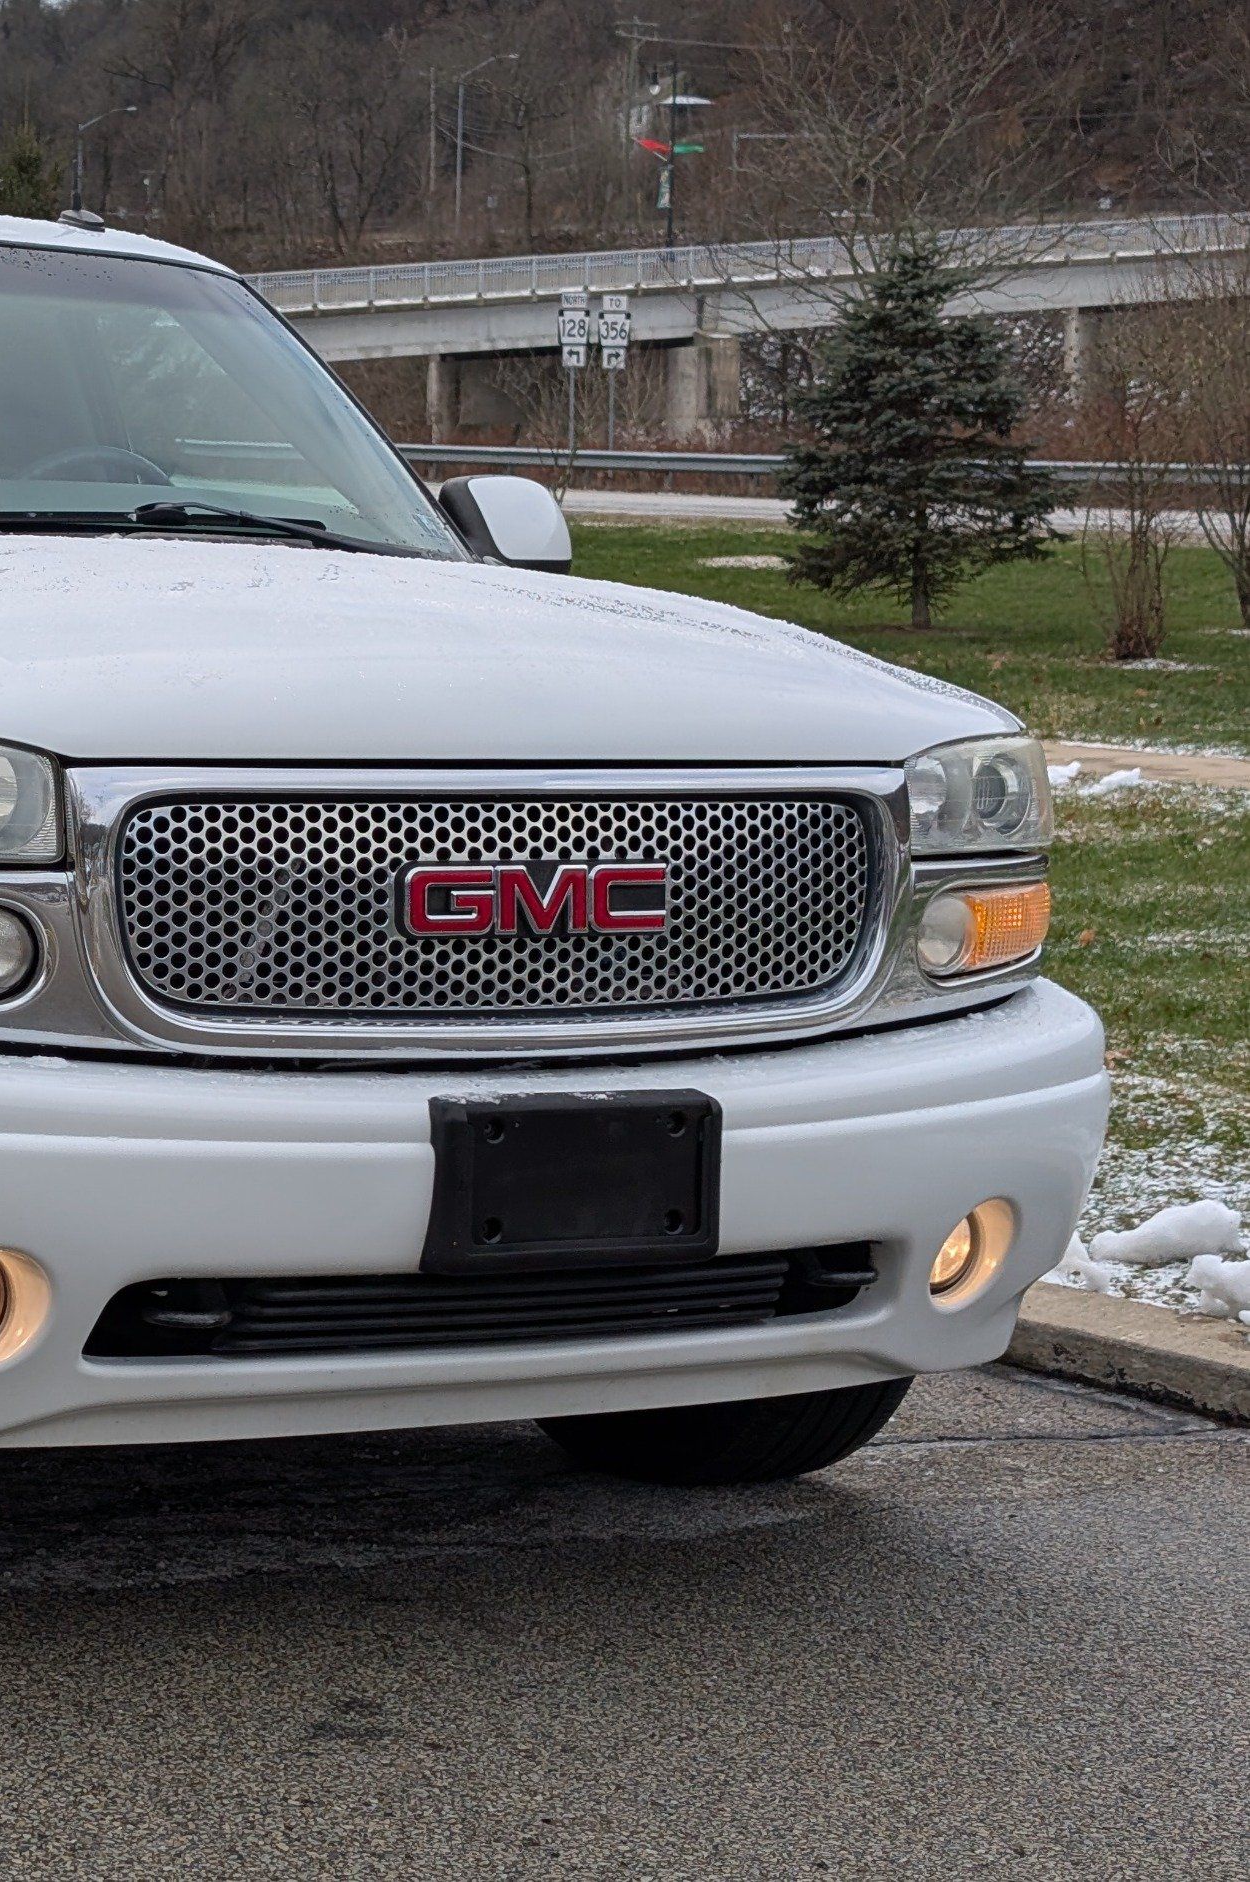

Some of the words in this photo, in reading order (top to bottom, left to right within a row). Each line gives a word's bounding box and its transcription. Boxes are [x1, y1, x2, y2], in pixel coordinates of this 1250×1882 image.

[609, 298, 622, 308] TO
[561, 319, 586, 338] 128
[600, 321, 627, 340] 356
[404, 863, 667, 936] GMC
